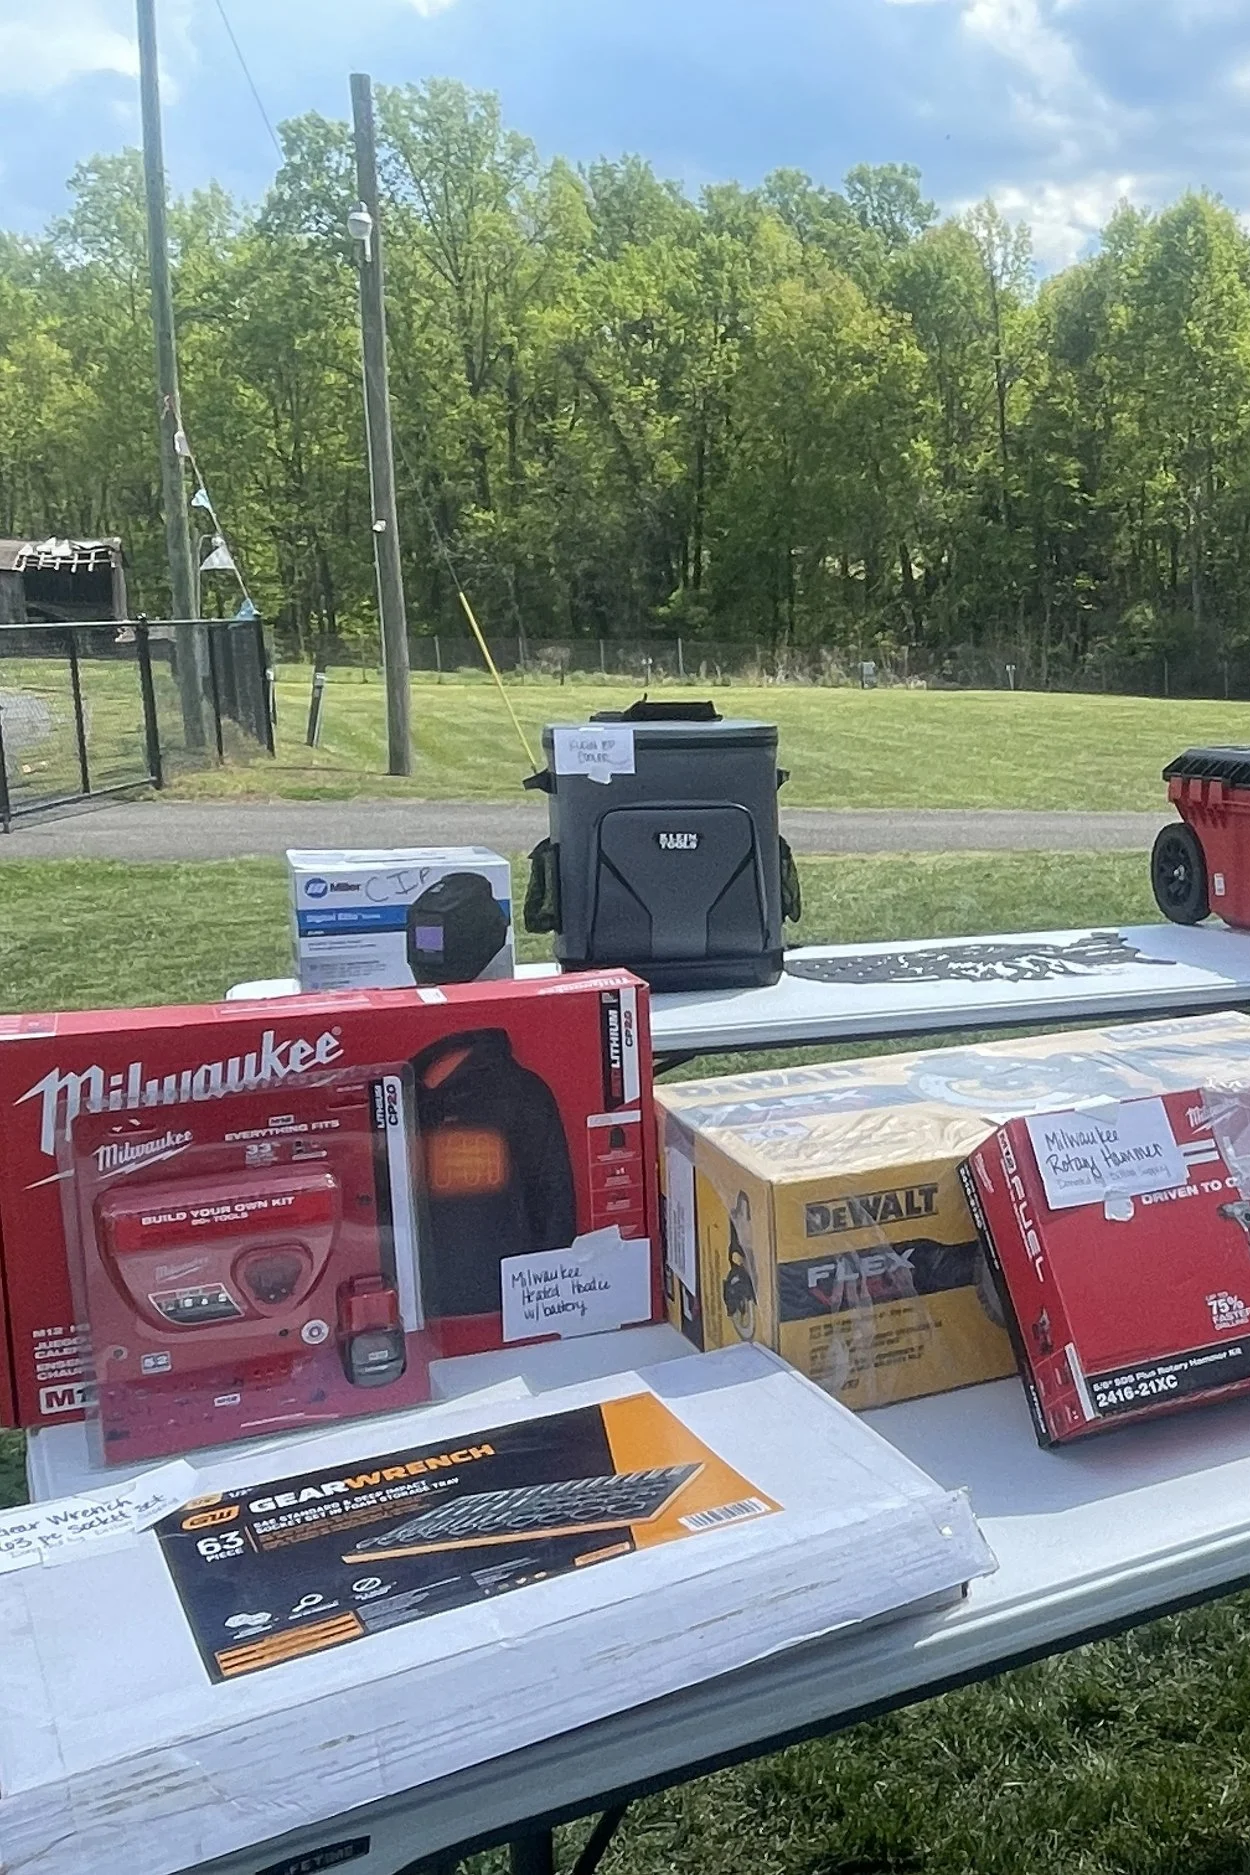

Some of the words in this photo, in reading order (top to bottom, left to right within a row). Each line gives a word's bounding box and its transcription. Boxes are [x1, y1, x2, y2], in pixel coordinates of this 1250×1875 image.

[659, 833, 697, 843] KLEIN
[659, 841, 697, 850] TOOLS
[330, 882, 361, 892] Miller
[13, 1029, 345, 1156] Milwaukee
[225, 1123, 308, 1141] EVERYTHING
[311, 1119, 340, 1131] FITS
[1044, 1124, 1119, 1152] Milwaukee
[92, 1129, 194, 1172] Milwaukee
[1103, 1141, 1164, 1168] Hammer
[1140, 1183, 1201, 1206] DRIVEN
[1200, 1179, 1222, 1194] TO
[141, 1211, 187, 1226] BUILD
[190, 1205, 232, 1218] YOUR
[234, 1199, 268, 1212] OWN
[271, 1196, 295, 1207] KIT
[213, 1211, 249, 1223] TOOLS
[806, 1185, 938, 1235] DEWALT
[1011, 1175, 1044, 1283] FUEL
[511, 1263, 583, 1289] Milwaukee
[807, 1247, 916, 1289] FLEX
[521, 1284, 561, 1306] Heated
[1207, 1294, 1245, 1315] 75%
[32, 1326, 64, 1339] M12
[1157, 1361, 1189, 1377] Rotary
[1189, 1351, 1228, 1368] Hammer
[1228, 1346, 1243, 1357] Kit
[1096, 1373, 1179, 1408] 2416-21XC
[249, 1443, 496, 1514] GEARWRENCH
[279, 1502, 341, 1521] STANDARD
[353, 1490, 384, 1503] DEEP
[386, 1479, 428, 1496] IMPACT
[344, 1498, 378, 1513] FOAM
[379, 1485, 431, 1504] STORAGE
[433, 1477, 460, 1488] TRAY
[46, 1498, 133, 1526] Wrench
[196, 1530, 245, 1557] 63
[205, 1547, 245, 1563] PIECE
